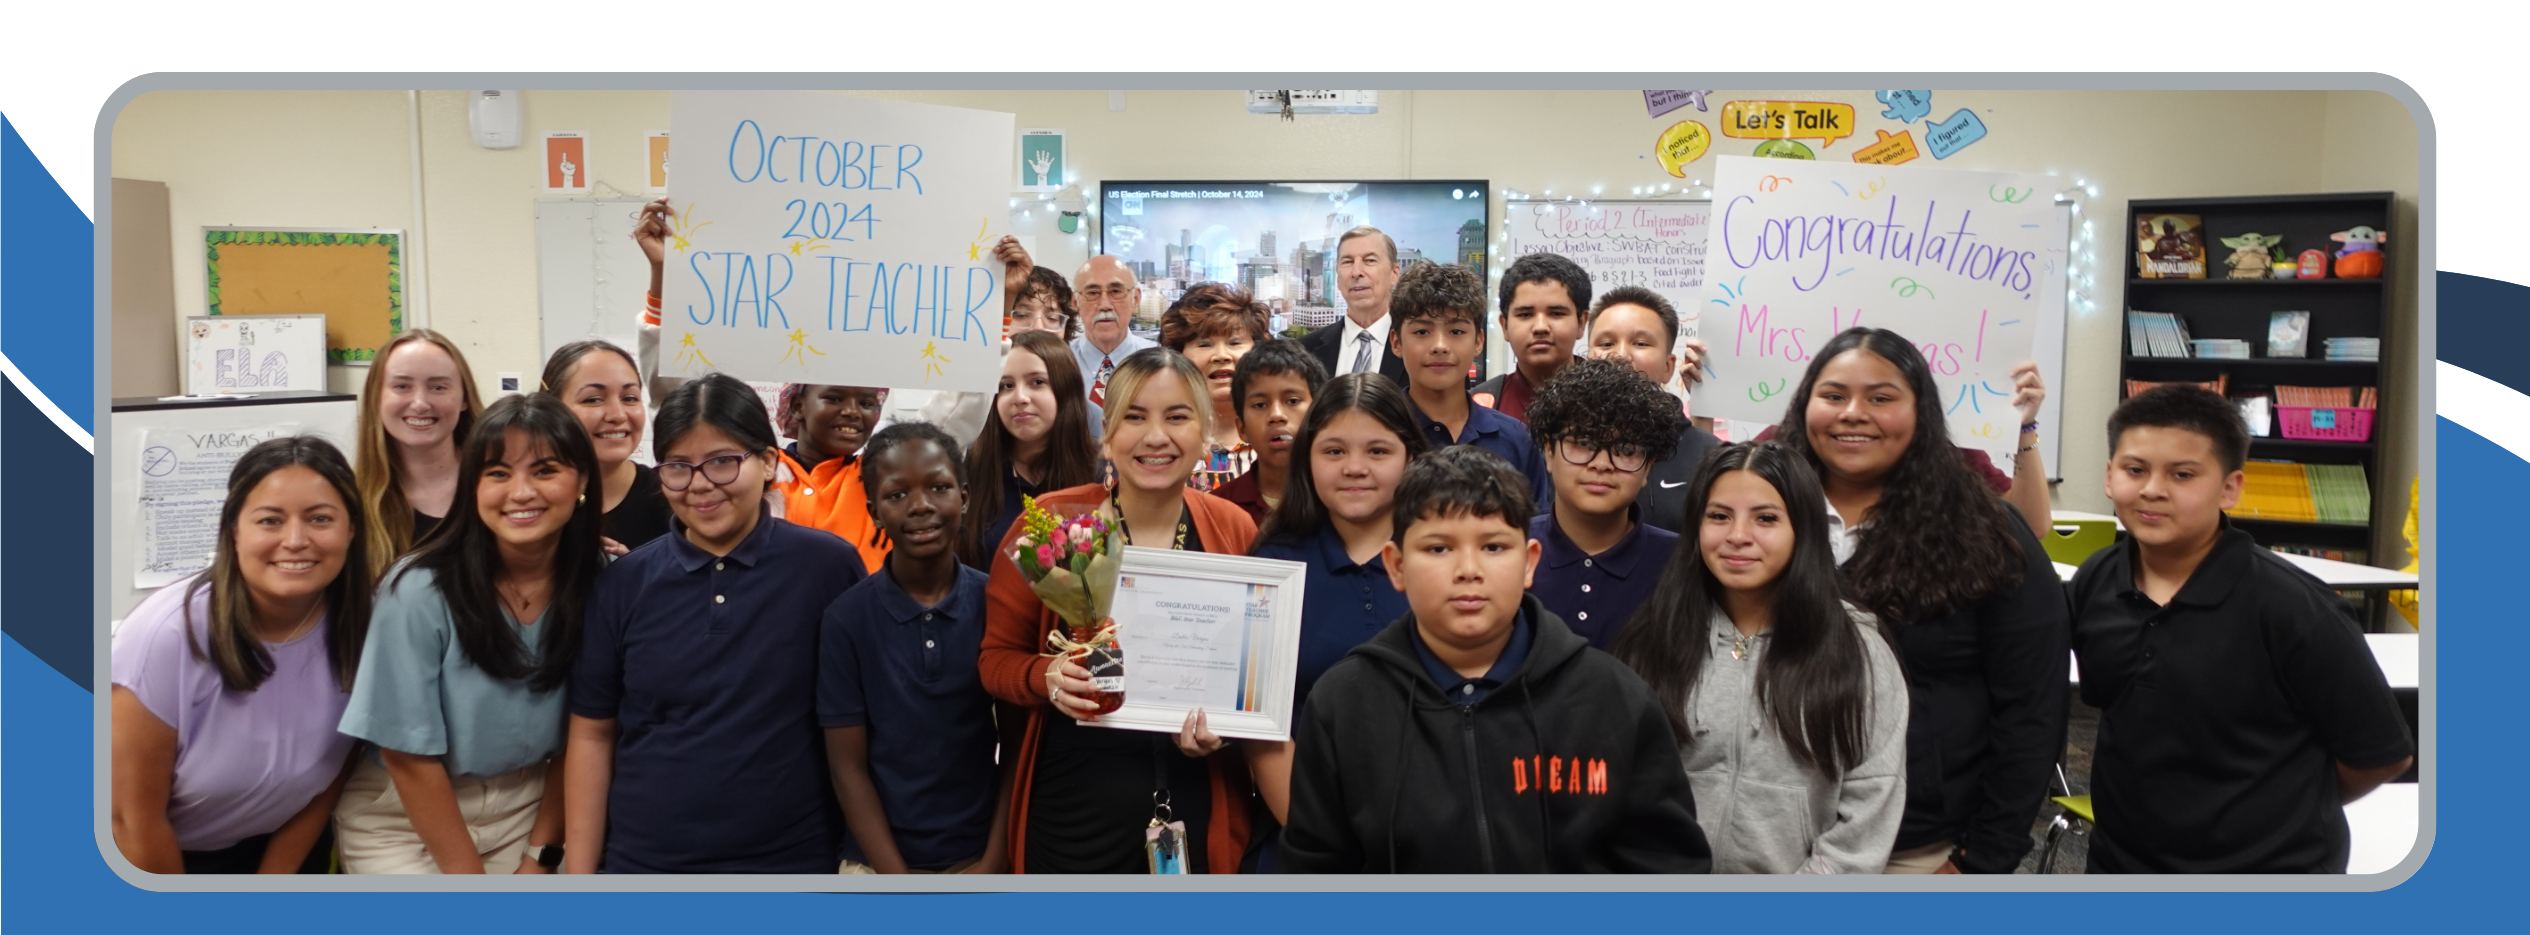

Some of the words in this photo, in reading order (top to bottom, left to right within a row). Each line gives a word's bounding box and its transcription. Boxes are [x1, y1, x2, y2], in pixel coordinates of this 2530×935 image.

[1652, 97, 1666, 107] but
[1736, 109, 1785, 130] Let's
[1794, 109, 1839, 130] Talk
[1933, 138, 1939, 146] I
[1938, 117, 1969, 142] figured
[1662, 146, 1668, 154] I
[1668, 129, 1700, 151] noticed
[1939, 143, 1949, 153] out
[1871, 146, 1891, 158] makes
[1108, 190, 1119, 198] US
[1120, 190, 1150, 198] Election
[1151, 190, 1168, 198] Final
[1170, 190, 1196, 198] Stretch
[1202, 190, 1231, 198] October
[1233, 190, 1243, 200] 14,
[1244, 190, 1264, 198] 2024
[782, 199, 882, 241] 2024
[1555, 205, 1611, 233] Period
[1614, 210, 1627, 230] 2
[1655, 227, 1686, 238] Honors
[1514, 238, 1554, 254] Lesson
[1612, 239, 1663, 254] SWBAT
[1724, 195, 2036, 300] Congratulations,
[1637, 254, 1666, 265] based
[2146, 262, 2203, 274] MANDALORIAN
[688, 251, 793, 330] STAR
[815, 255, 994, 347] TEACHER
[1736, 303, 1811, 363] Mrs.
[215, 347, 288, 388] ELA
[187, 433, 260, 449] VARGAS
[1155, 601, 1231, 613] CONGRATULATIONS!
